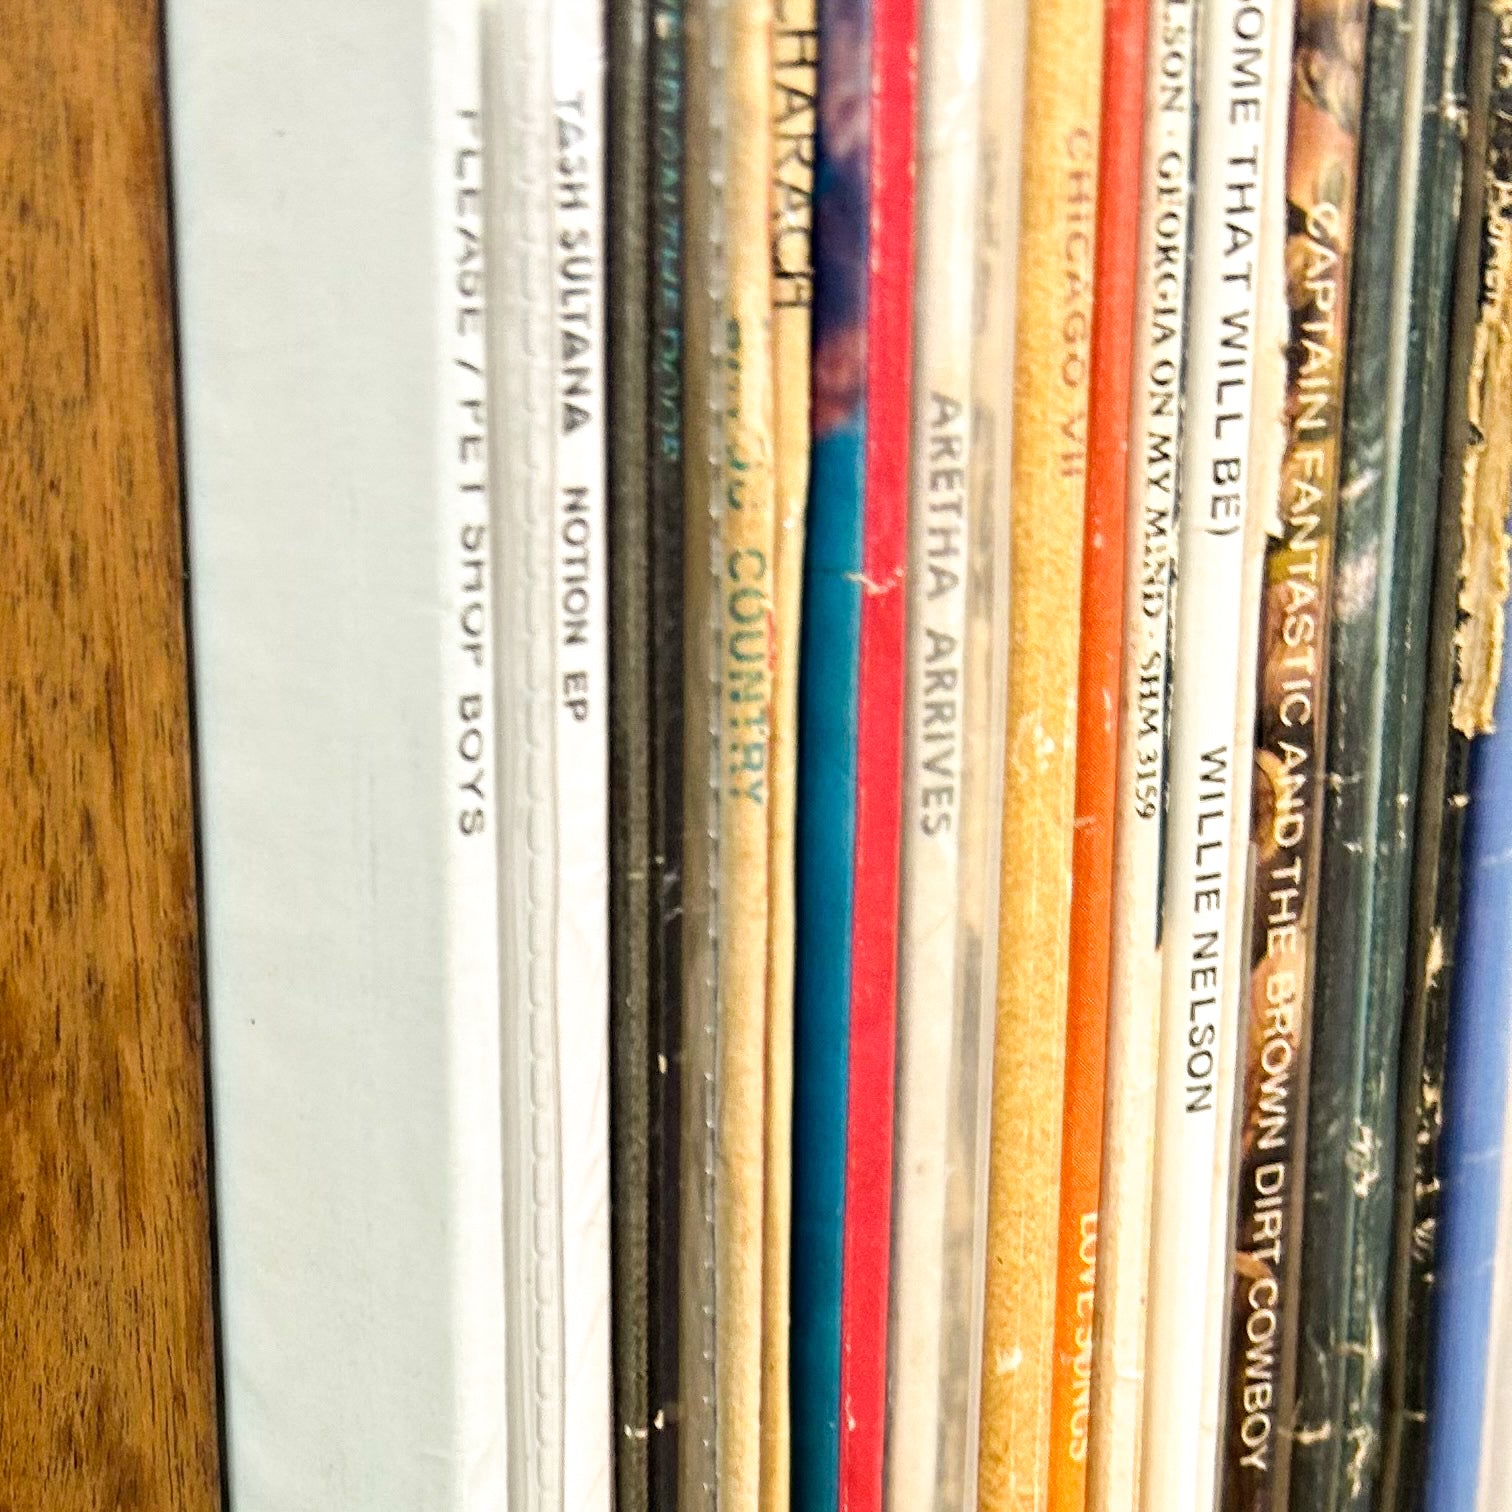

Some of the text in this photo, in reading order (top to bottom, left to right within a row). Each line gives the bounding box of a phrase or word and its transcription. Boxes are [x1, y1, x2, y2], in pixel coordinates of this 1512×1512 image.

[1060, 127, 1094, 478] CHICAGO VII
[1150, 150, 1186, 346] GEORGIA
[556, 92, 595, 723] TASH SULTANA NOTION EP
[1145, 431, 1174, 494] MY
[1147, 358, 1178, 418] ON
[727, 548, 768, 806] COUNTRY
[920, 390, 965, 839] ARETHA ARRIVES
[1184, 0, 1265, 1116] OME THAT WILL BE) WILLIE NELSON
[458, 692, 488, 837] BOYS
[1134, 749, 1160, 822] 3159
[1238, 200, 1343, 1473] CAPTAIN FANTASTIC AND THE BROWN DIRT COWBOY
